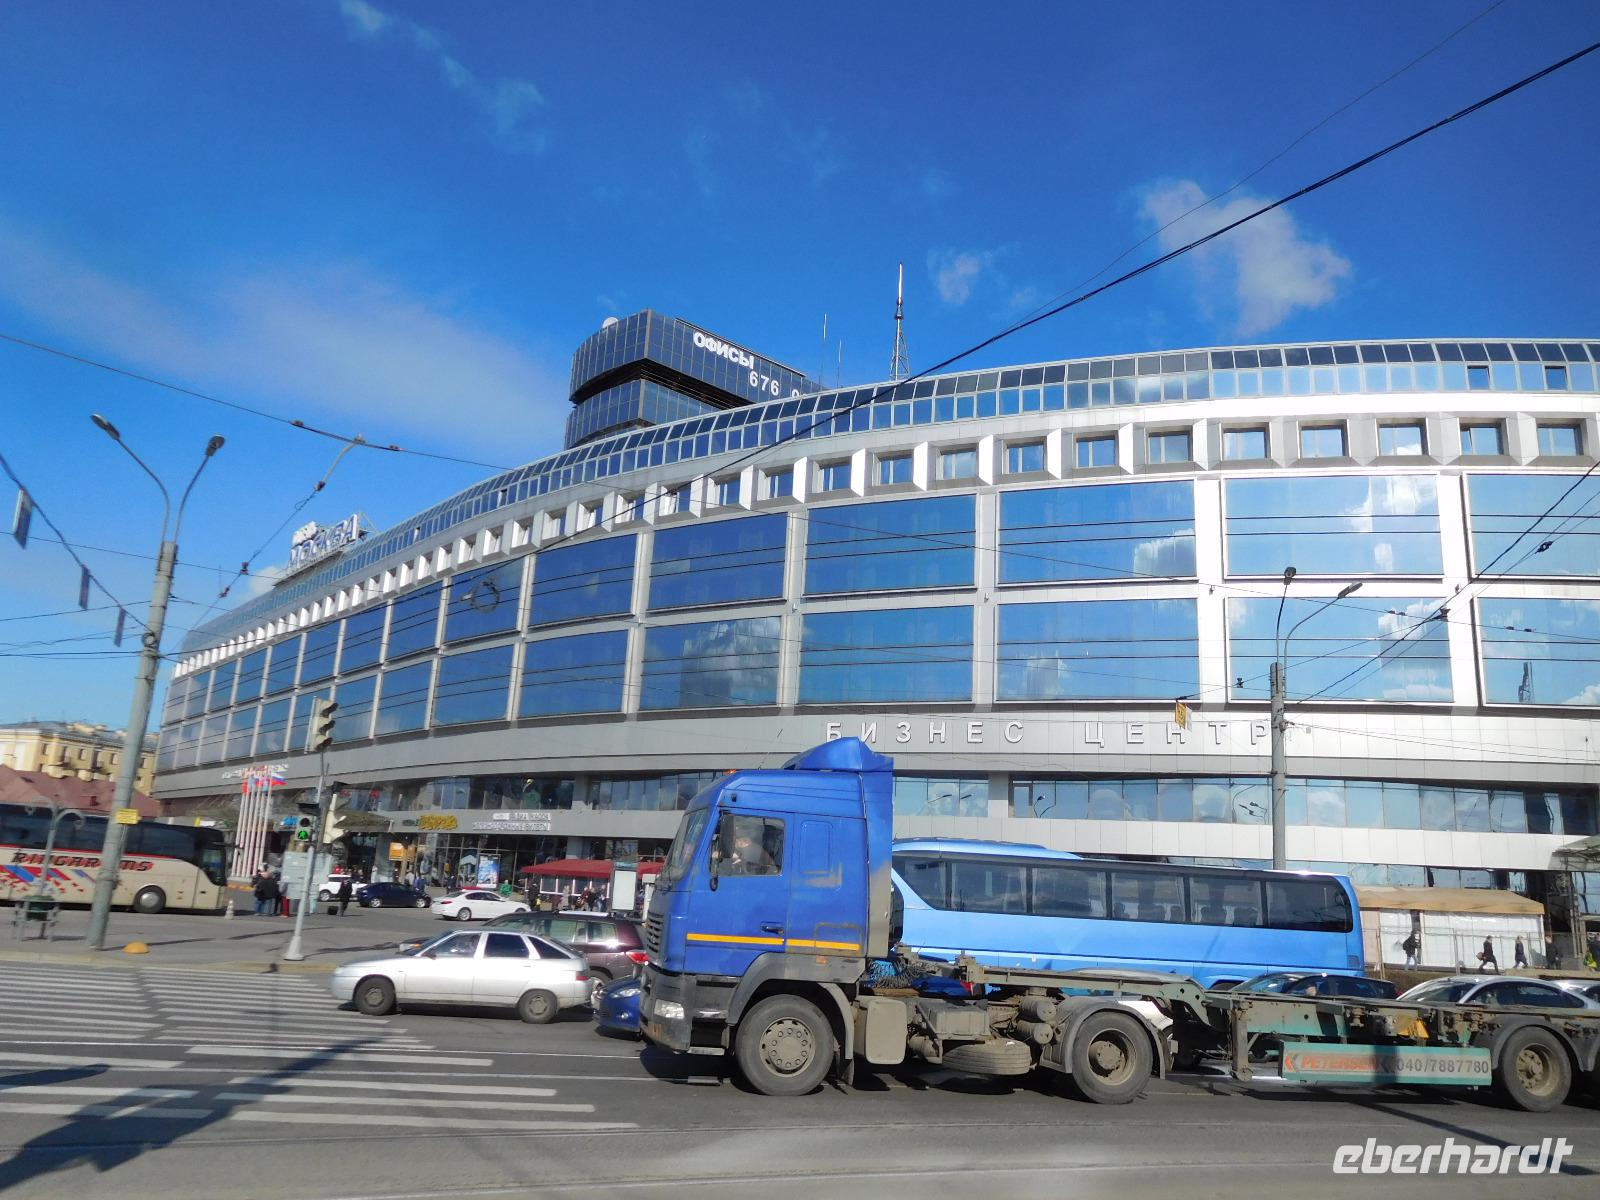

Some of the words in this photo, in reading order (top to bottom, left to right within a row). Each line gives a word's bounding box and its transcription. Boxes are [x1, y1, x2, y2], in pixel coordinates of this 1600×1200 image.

[693, 332, 755, 370] ОФИСЫ
[749, 370, 780, 396] 676
[826, 721, 1024, 745] БИЗНЕС
[1085, 719, 1270, 748] ЦЕНТР
[1396, 1058, 1490, 1074] 040/7887780
